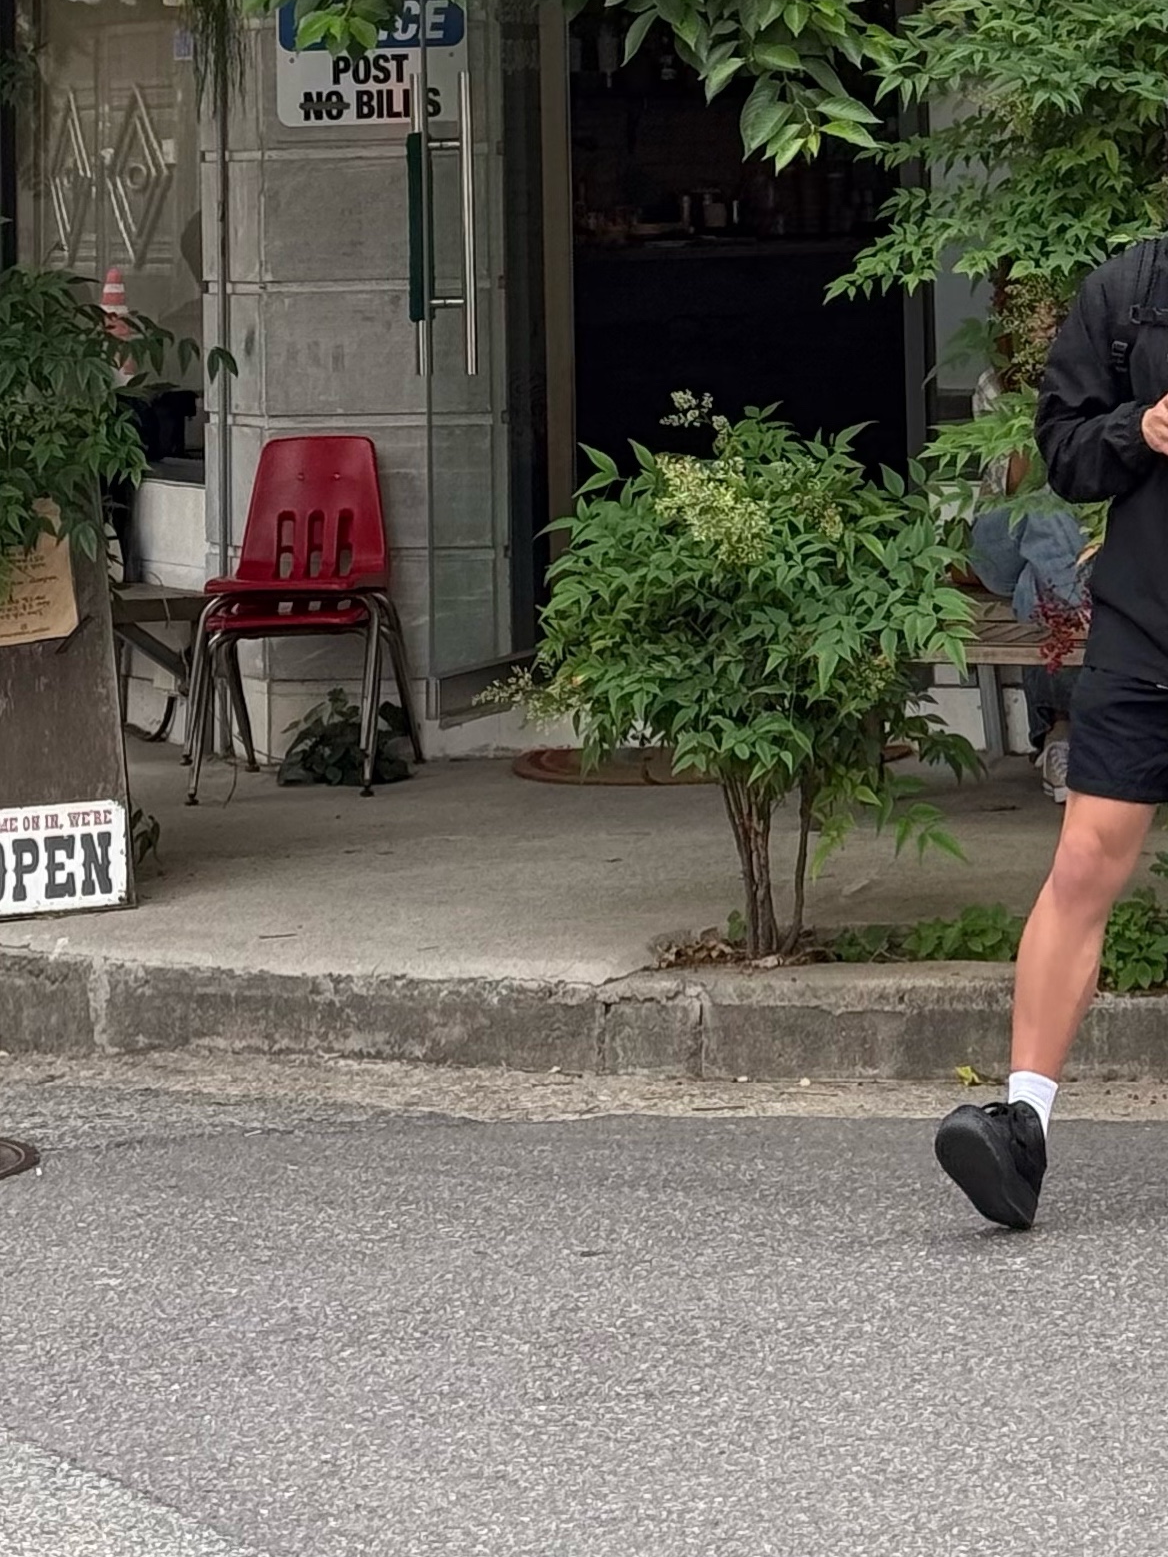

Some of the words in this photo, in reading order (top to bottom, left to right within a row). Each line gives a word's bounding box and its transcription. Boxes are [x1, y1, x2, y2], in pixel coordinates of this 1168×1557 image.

[332, 53, 409, 85] POST
[303, 91, 345, 121] NO
[0, 817, 18, 833] ME
[22, 815, 40, 831] ON
[45, 813, 64, 830] IN,
[67, 809, 112, 828] WE'RE
[0, 831, 112, 902] PEN
